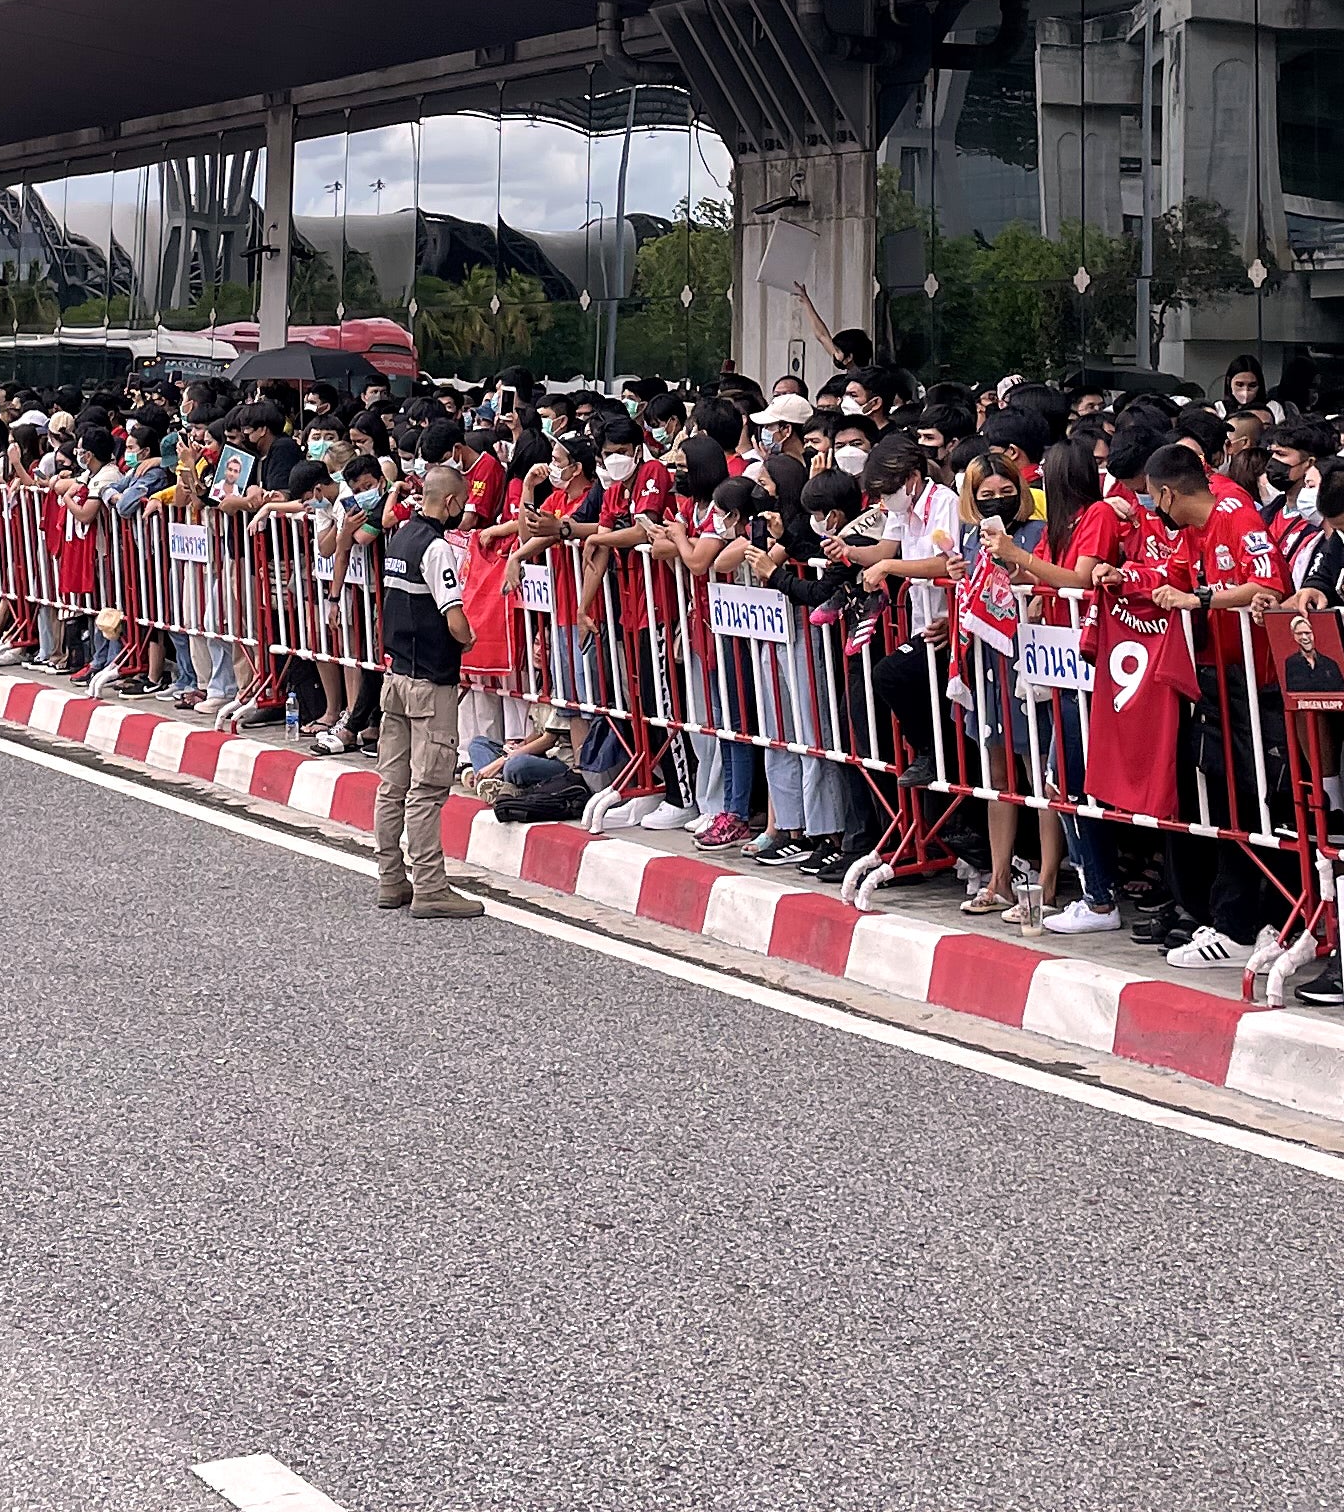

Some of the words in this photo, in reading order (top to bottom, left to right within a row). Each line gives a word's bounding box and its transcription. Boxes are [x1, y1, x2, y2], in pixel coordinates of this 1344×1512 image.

[442, 568, 457, 589] 9
[714, 587, 784, 634] ส่วนจราจร
[1109, 640, 1149, 713] 9
